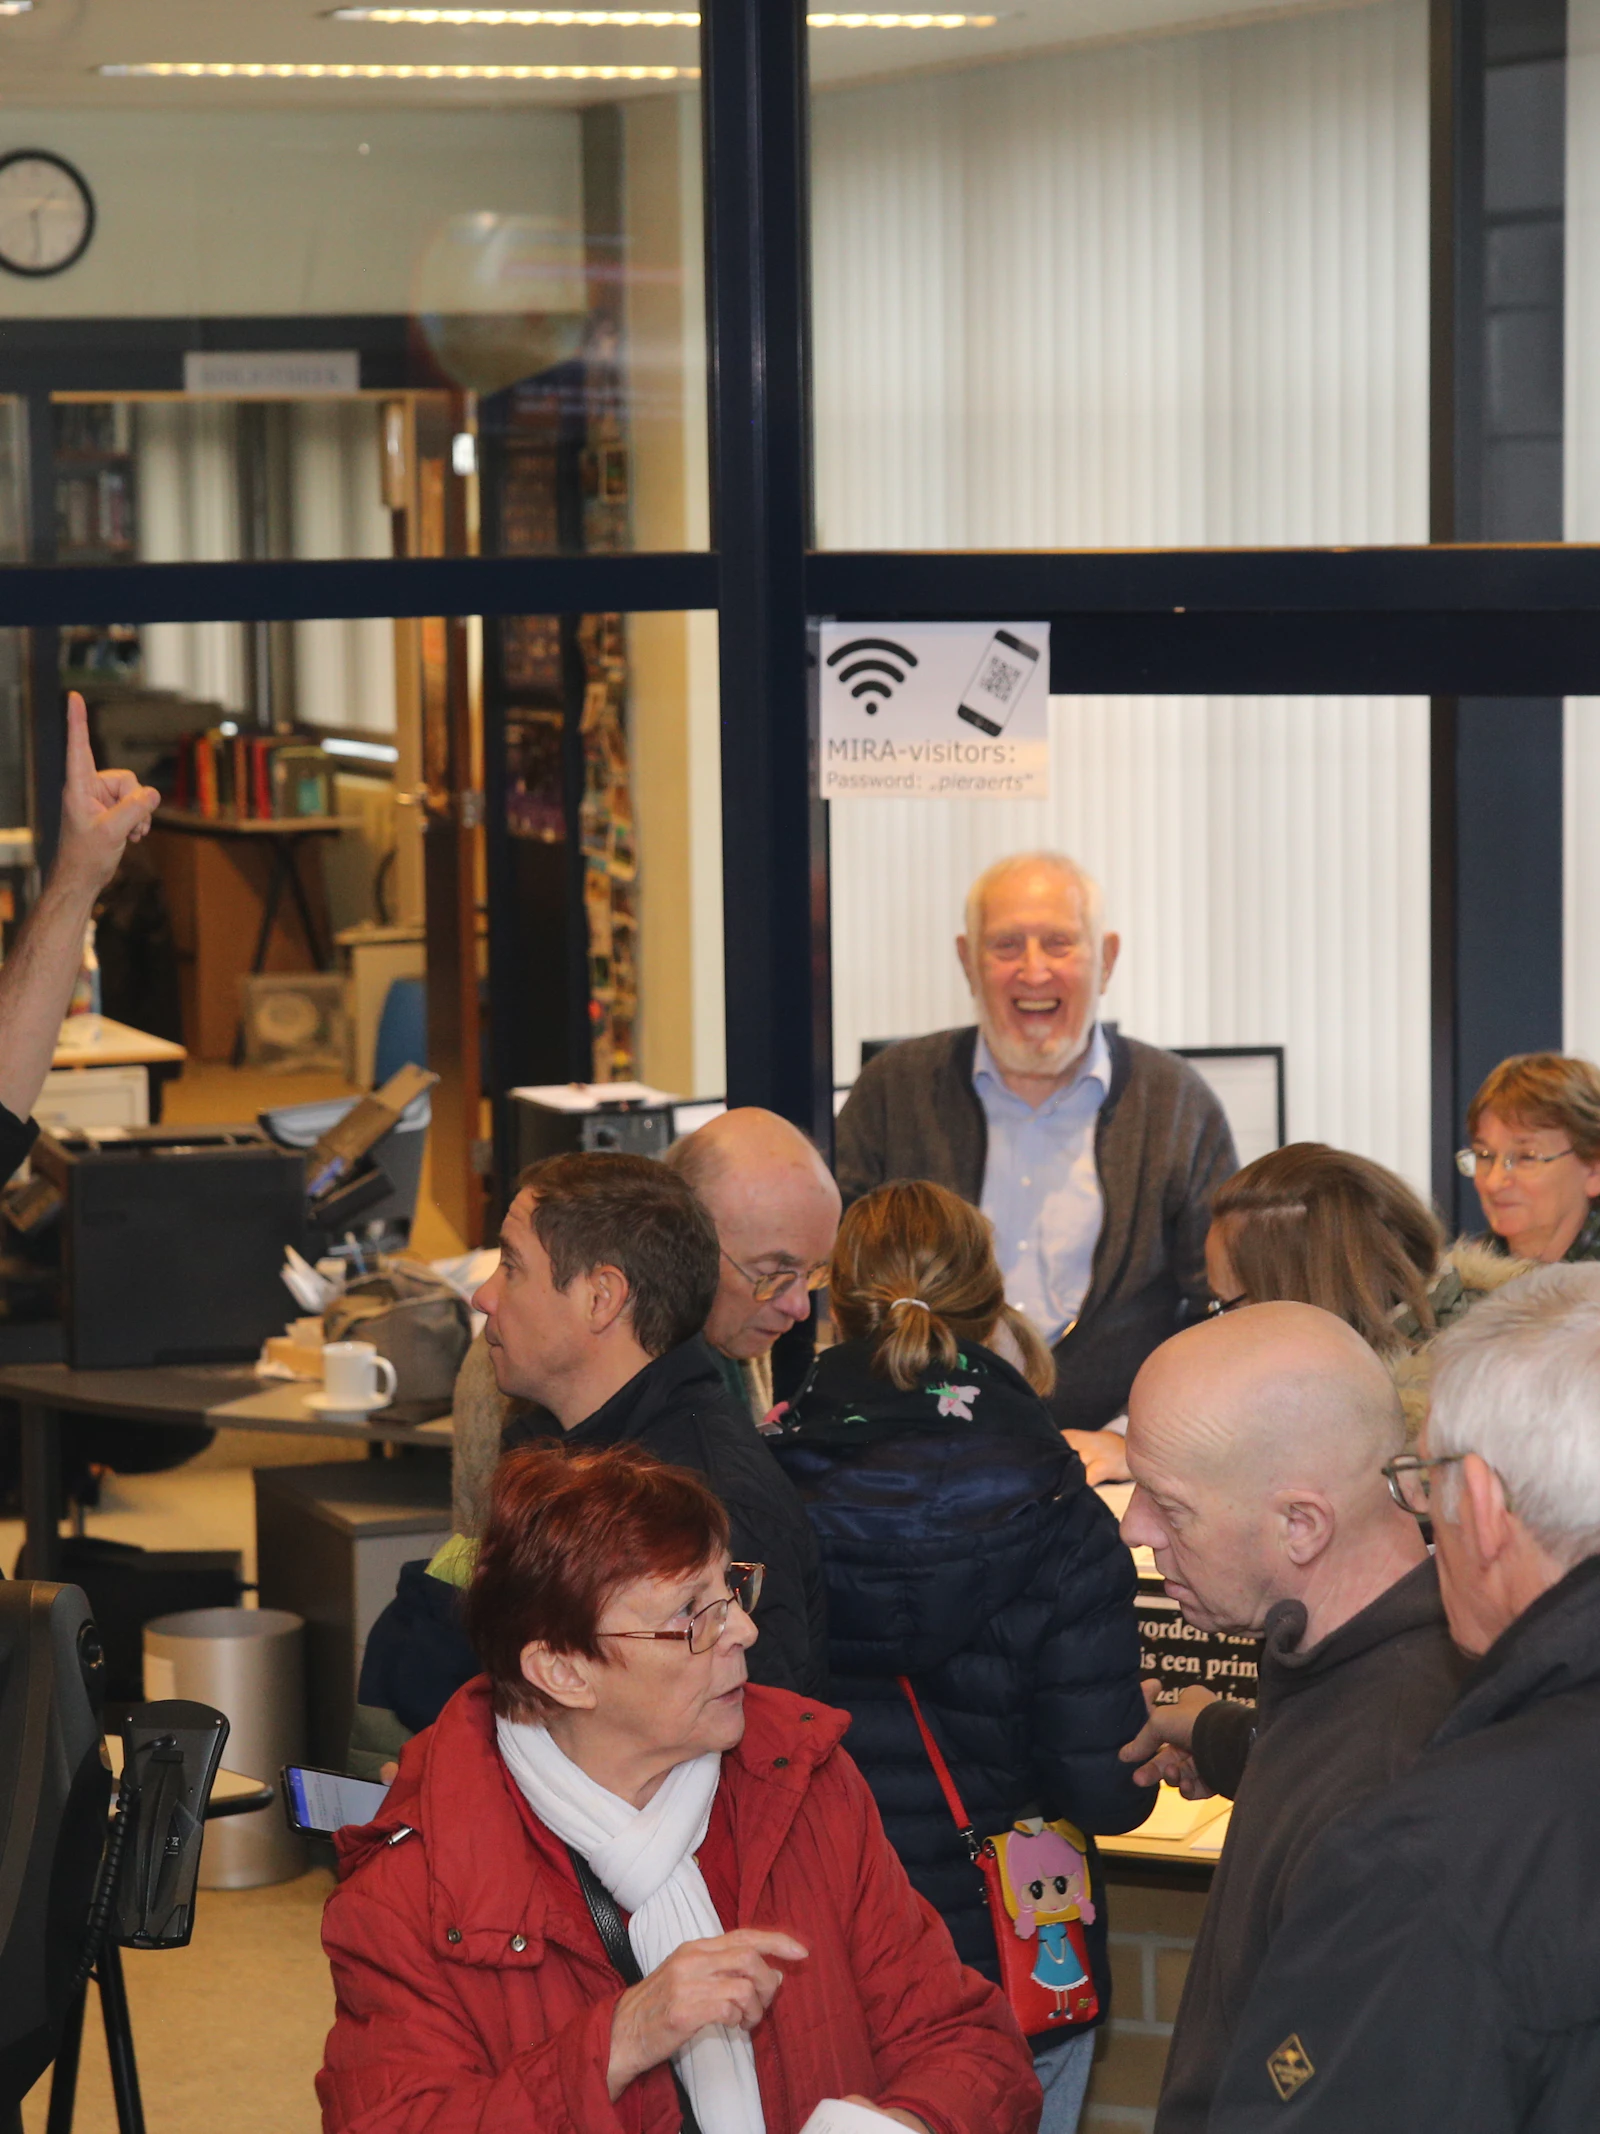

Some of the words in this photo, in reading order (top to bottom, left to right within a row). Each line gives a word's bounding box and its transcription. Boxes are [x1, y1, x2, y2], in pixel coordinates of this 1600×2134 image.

[827, 739, 1016, 764] MIRA-visitors:
[826, 771, 922, 790] Password:
[1161, 1654, 1200, 1673] een
